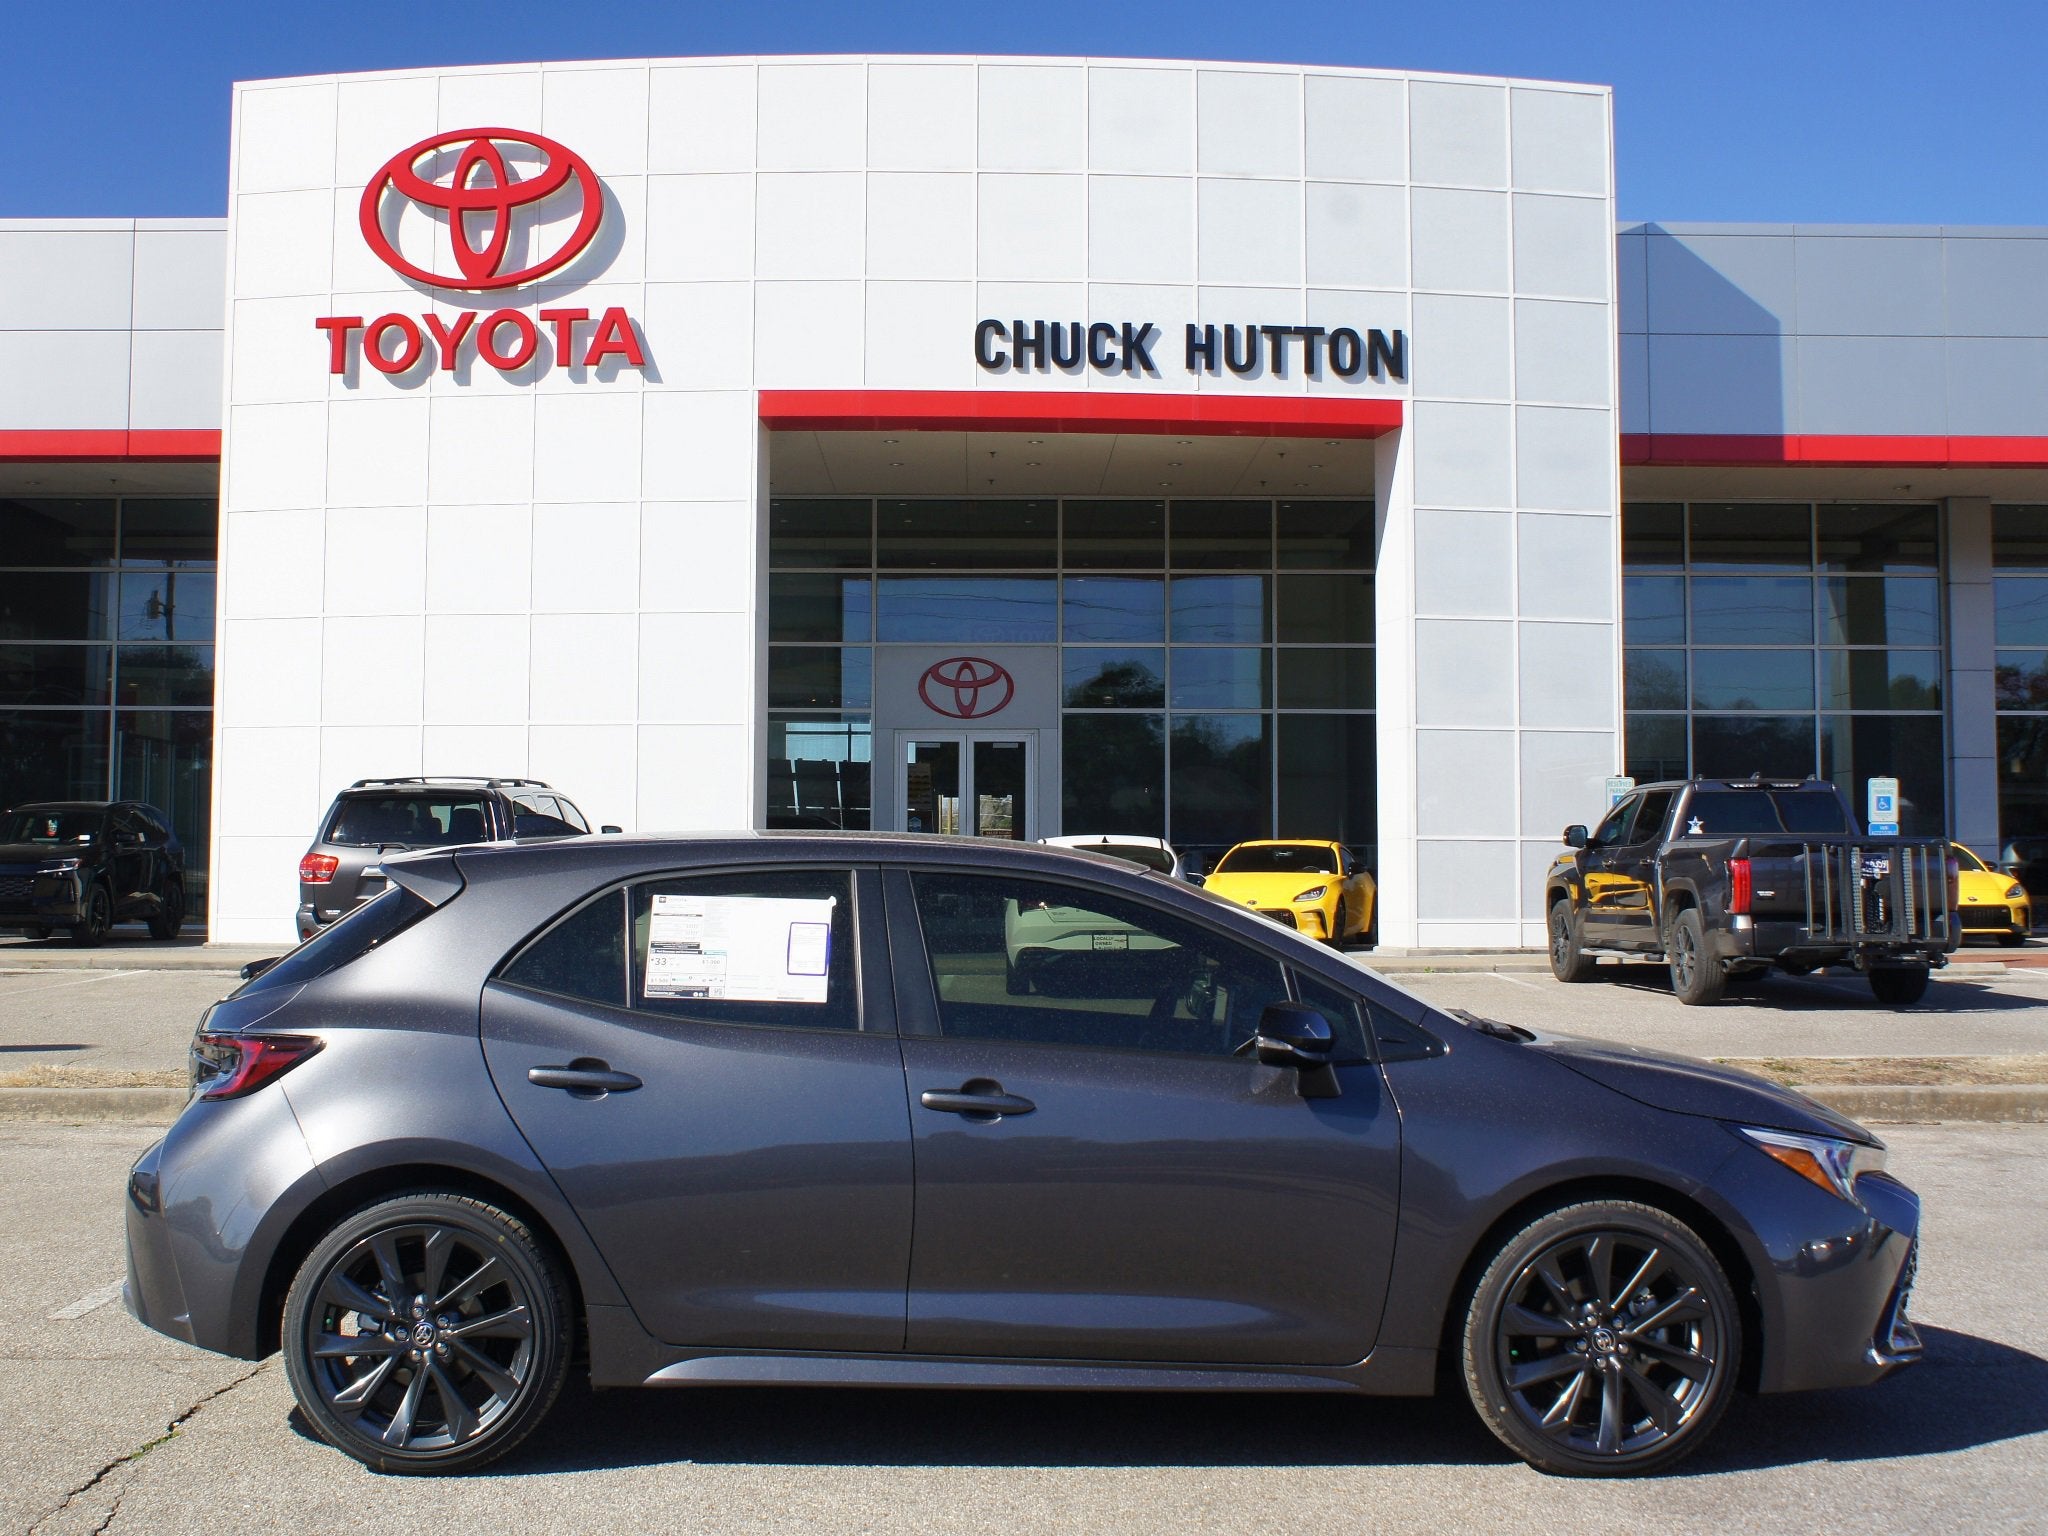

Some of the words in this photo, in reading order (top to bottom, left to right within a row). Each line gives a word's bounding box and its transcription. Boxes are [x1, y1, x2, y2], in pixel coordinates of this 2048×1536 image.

[315, 307, 646, 374] TOYOTA
[974, 319, 1155, 371] CHUCK
[1185, 323, 1405, 378] HUTTON
